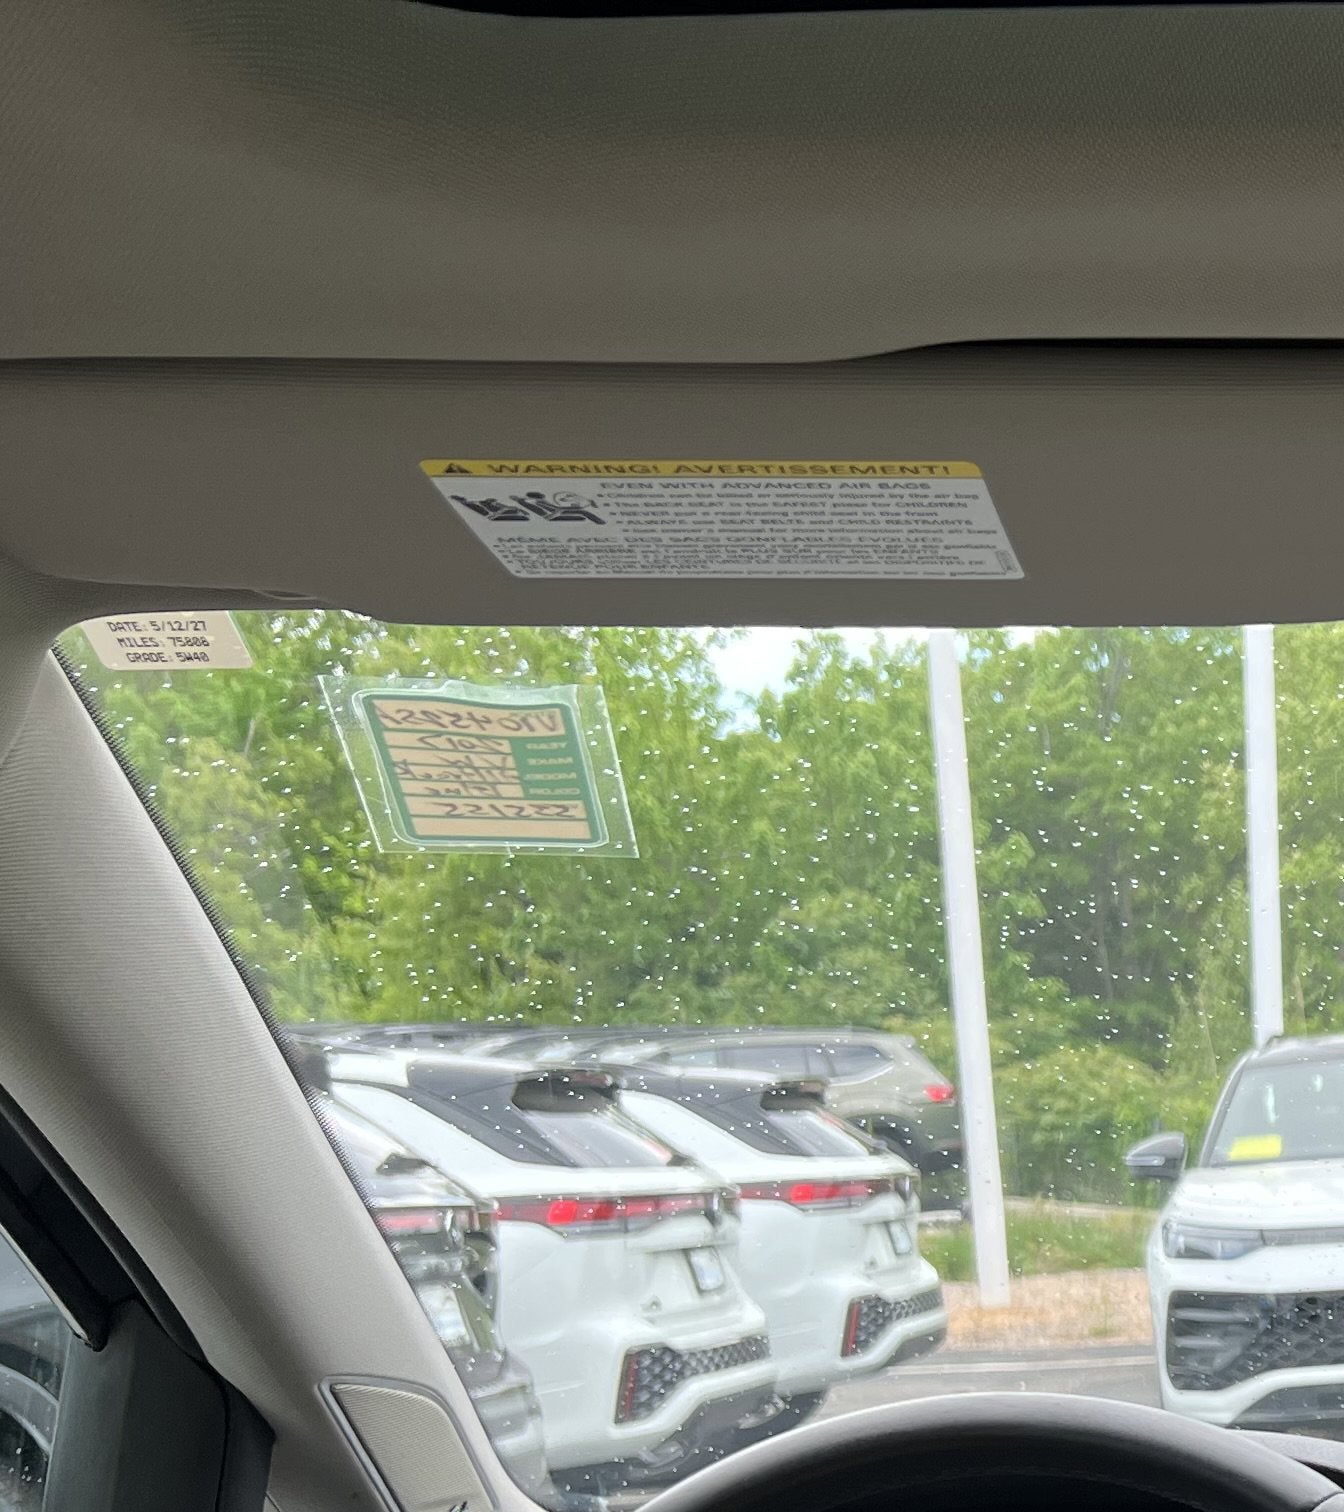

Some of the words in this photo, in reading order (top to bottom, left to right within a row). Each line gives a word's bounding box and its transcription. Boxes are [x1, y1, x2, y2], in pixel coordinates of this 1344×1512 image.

[487, 464, 661, 474] WARNING!
[675, 464, 951, 475] AVERTISSEMENT!
[106, 621, 149, 632] DATE:
[150, 620, 207, 631] 5/12/27
[116, 637, 165, 648] MILES:
[126, 652, 172, 663] GRADE:
[175, 652, 210, 662] 5W40
